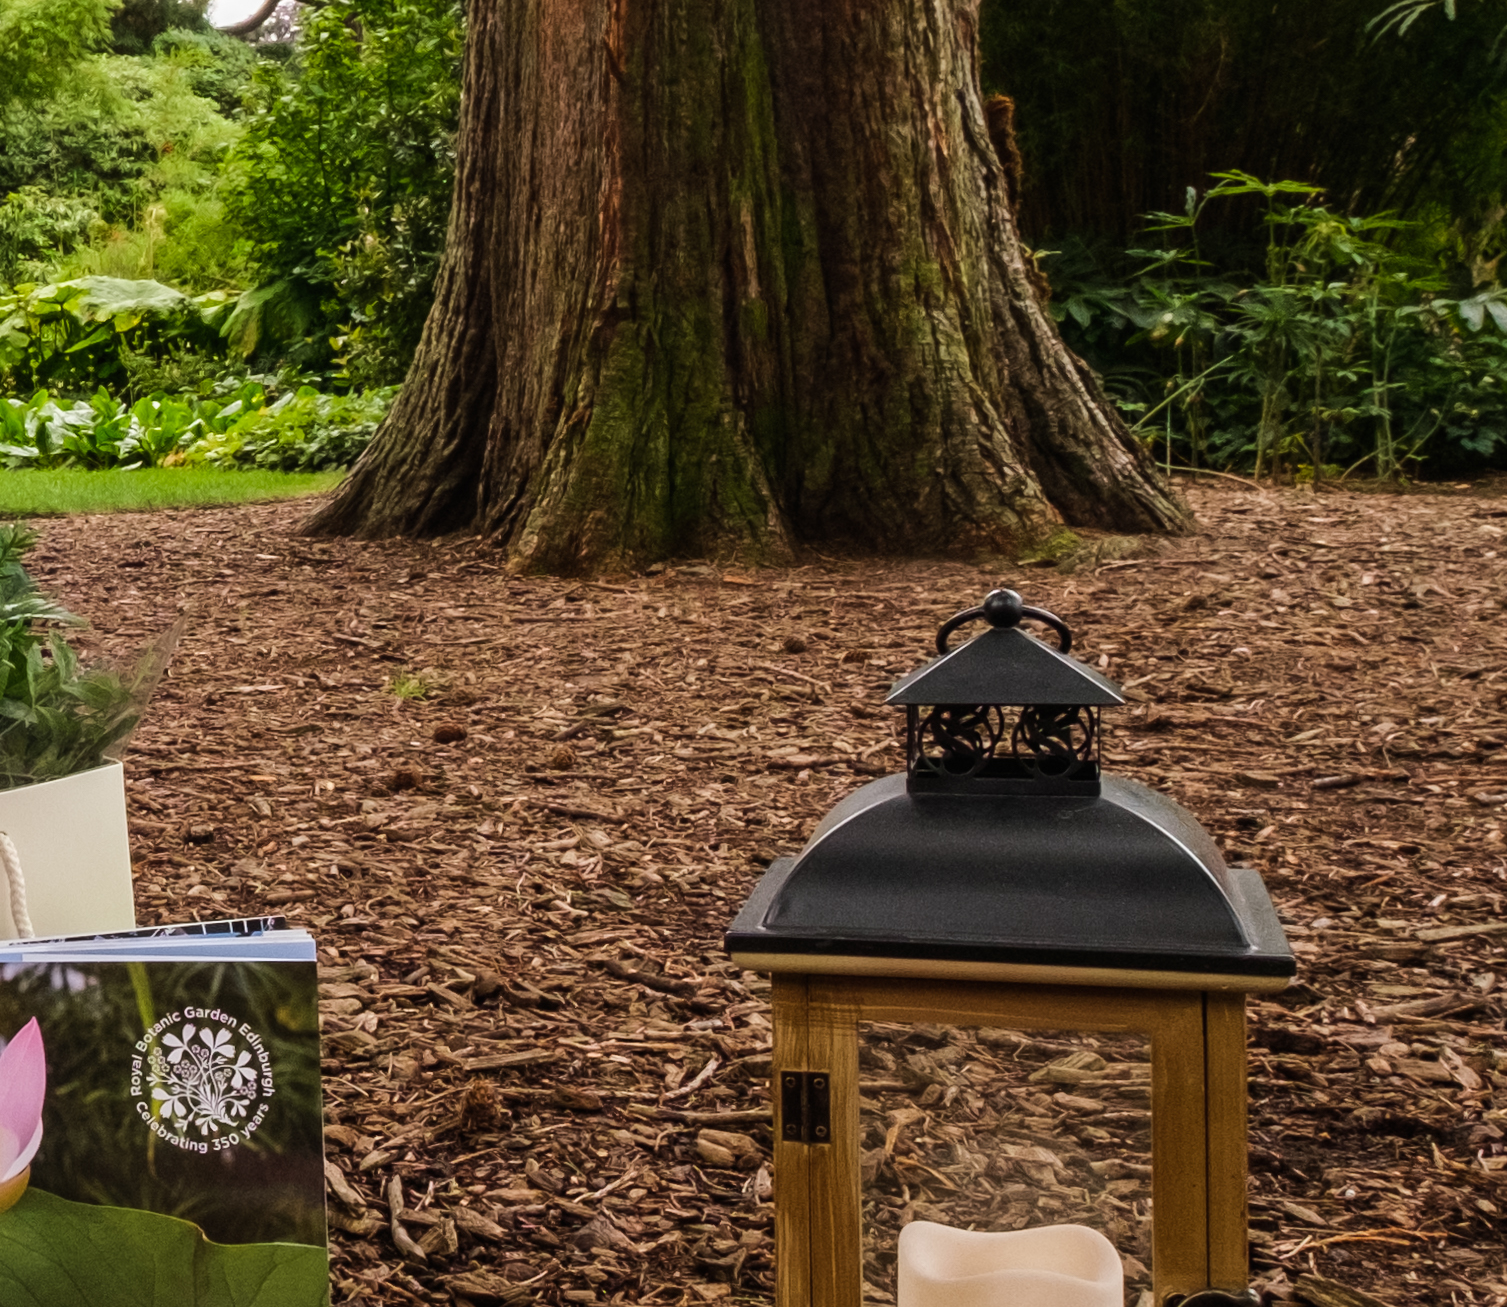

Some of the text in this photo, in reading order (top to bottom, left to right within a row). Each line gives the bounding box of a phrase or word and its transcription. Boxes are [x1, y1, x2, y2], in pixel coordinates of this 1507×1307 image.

[130, 1006, 276, 1097] Royal Botanic Garden Edinburgh
[136, 1101, 269, 1154] Celebrating 350 years
